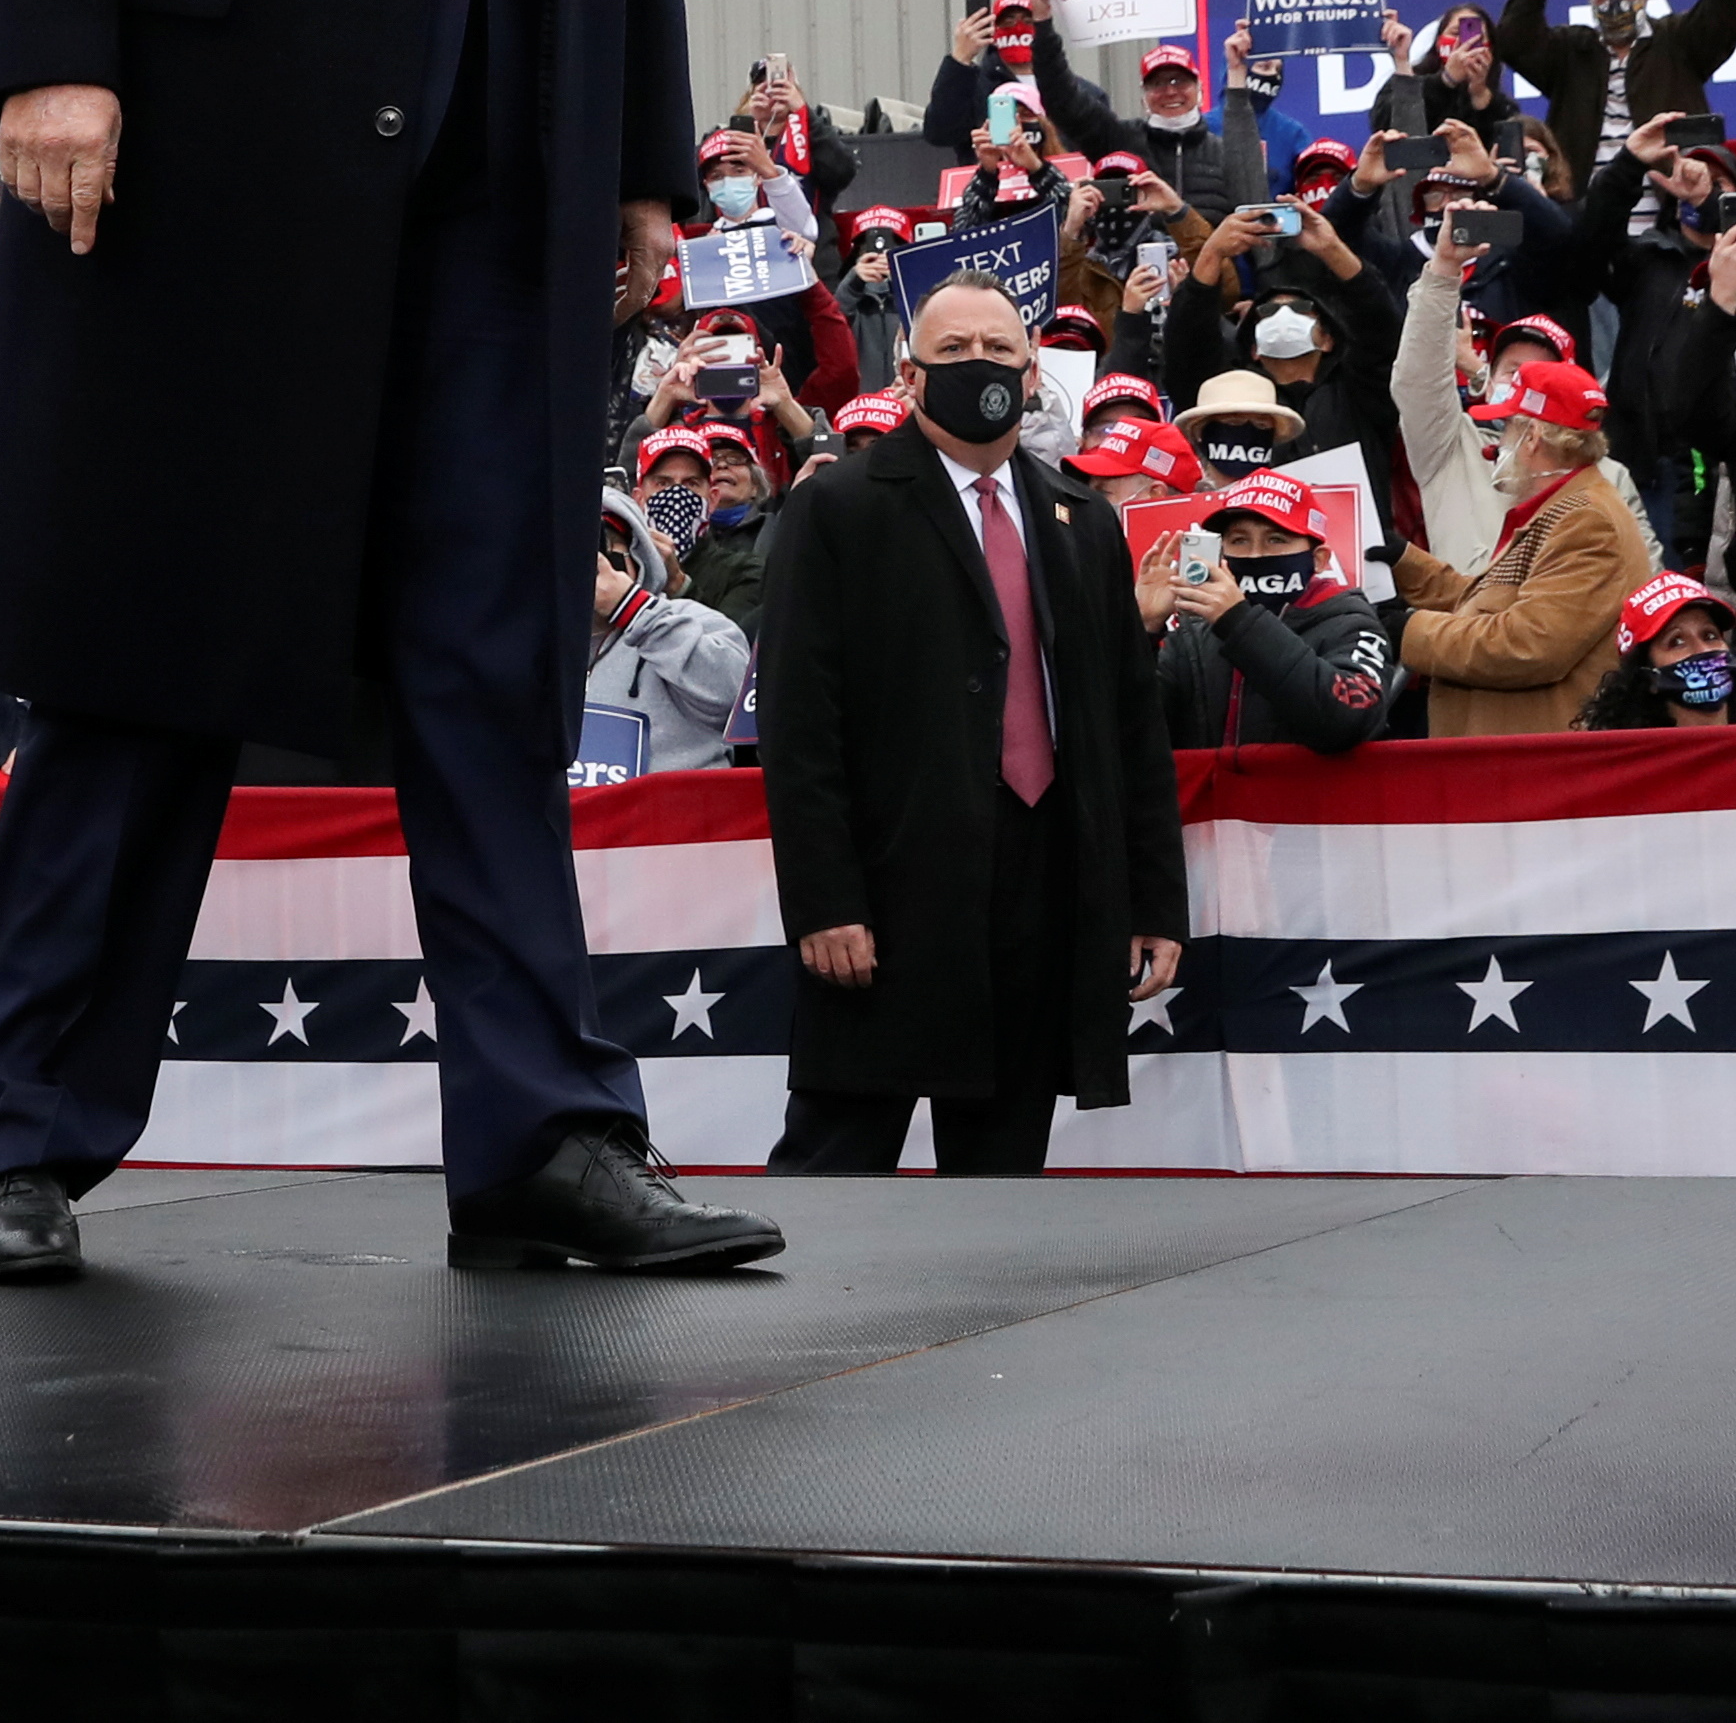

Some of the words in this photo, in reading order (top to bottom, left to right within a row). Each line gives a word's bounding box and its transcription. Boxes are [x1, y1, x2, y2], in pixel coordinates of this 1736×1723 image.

[1087, 3, 1139, 24] TEXT
[1274, 10, 1301, 23] FOR
[1304, 9, 1357, 22] TRUMP
[995, 33, 1035, 49] MAG
[1246, 76, 1280, 96] MAG
[754, 227, 768, 257] TRUM
[726, 227, 755, 299] Worke
[955, 240, 1022, 273] TEXT
[1020, 293, 1049, 325] 022
[1106, 376, 1152, 397] AMERICA
[861, 397, 903, 416] AMERICA
[839, 411, 864, 427] GREAT
[865, 409, 897, 427] AGAIN
[643, 429, 668, 446] MAKE
[669, 428, 708, 446] AMERICA
[648, 439, 675, 455] GREAT
[675, 437, 704, 454] AGAIN
[1208, 443, 1272, 464] MAGA
[1254, 474, 1302, 501] AMERICA
[1258, 489, 1292, 514] AGAIN
[1241, 572, 1305, 594] AGA
[1628, 577, 1662, 608] MAKE
[1642, 590, 1678, 617] GREAT
